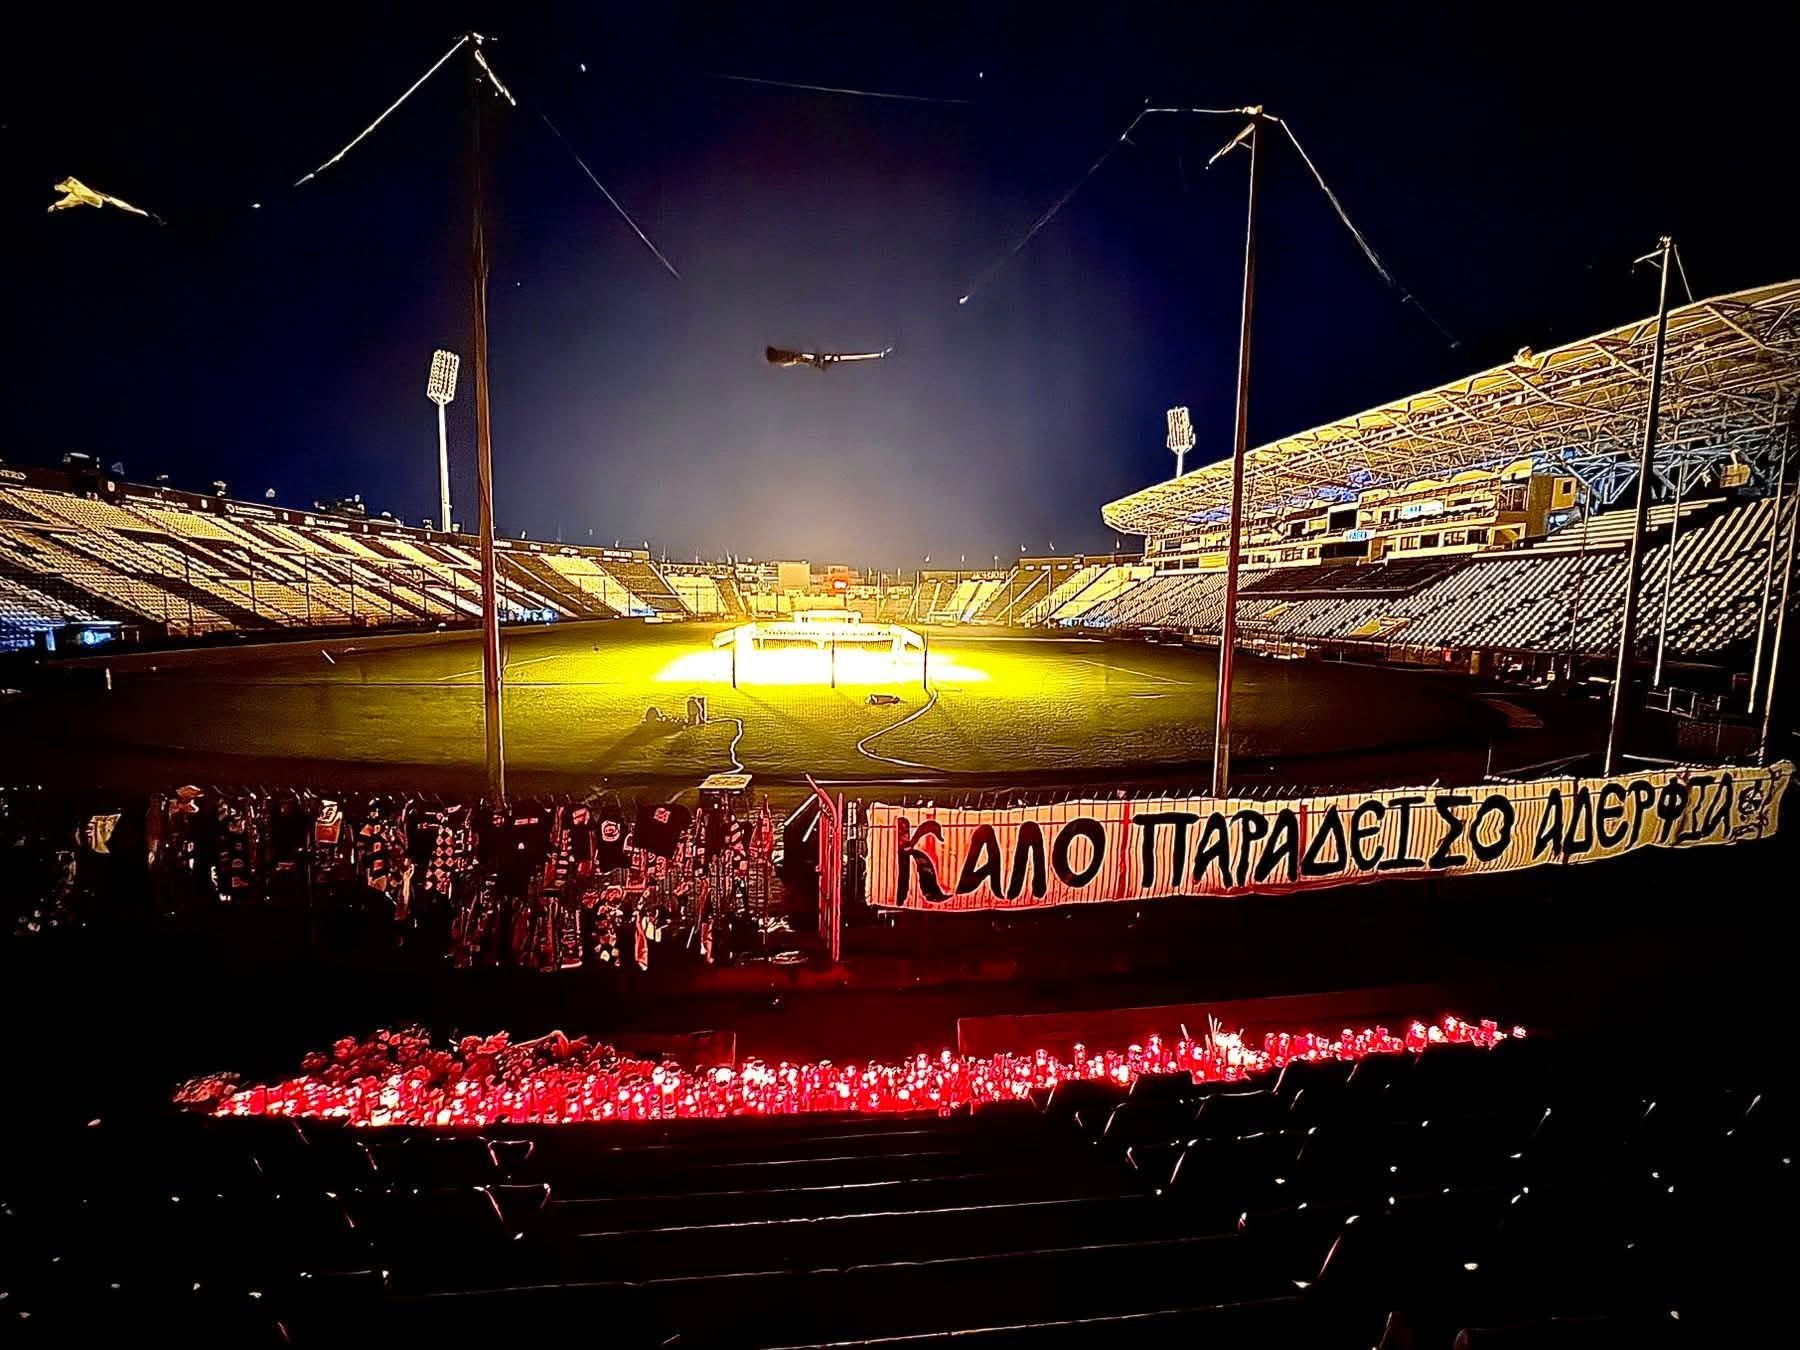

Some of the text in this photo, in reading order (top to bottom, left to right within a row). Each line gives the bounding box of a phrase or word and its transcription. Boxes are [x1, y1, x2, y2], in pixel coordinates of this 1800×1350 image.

[896, 816, 1107, 905] ΚΑΛΟ
[1132, 795, 1516, 889] ΠΑΡΑΔΕΙΣΟ
[1534, 771, 1733, 859] ΑΔΕΡΦΙΑ
